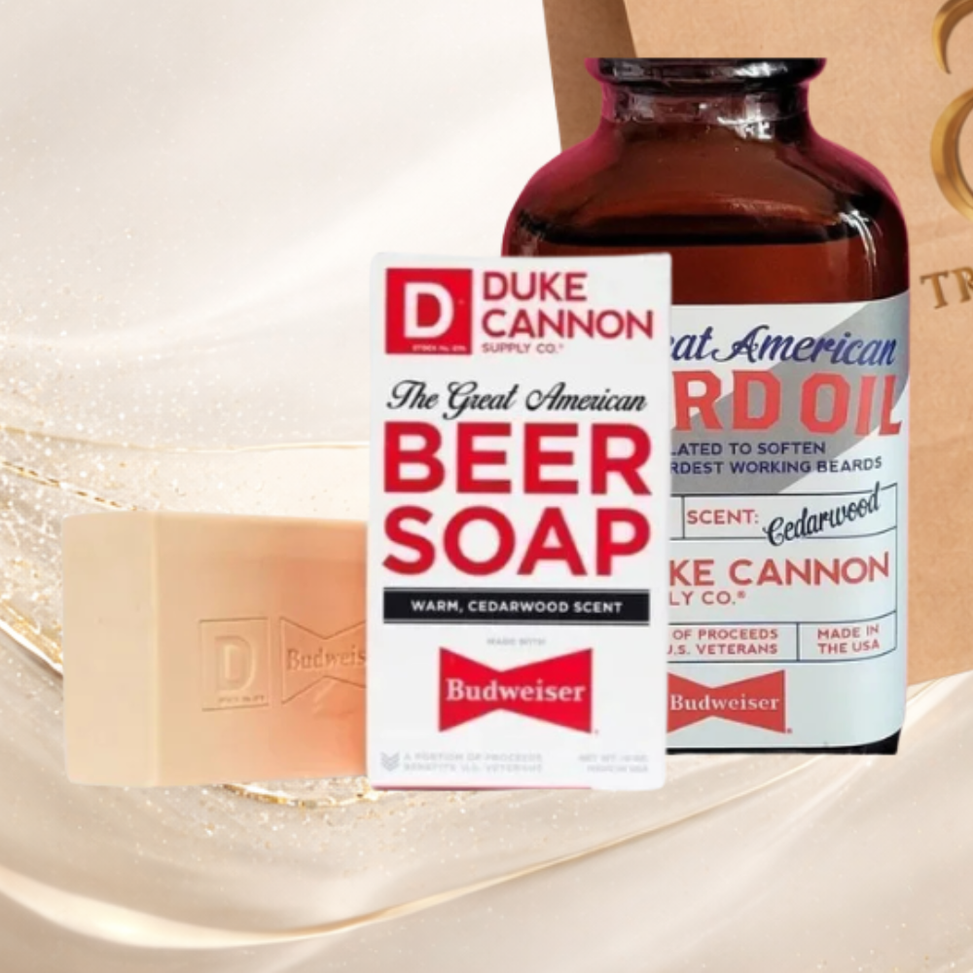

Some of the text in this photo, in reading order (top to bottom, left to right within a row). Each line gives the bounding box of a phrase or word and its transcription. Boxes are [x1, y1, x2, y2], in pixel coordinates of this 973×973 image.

[482, 272, 588, 301] DUKE
[404, 282, 454, 339] D
[481, 309, 653, 340] CANNON
[481, 342, 530, 354] SUPPLY
[670, 324, 897, 365] at American
[386, 380, 647, 420] The Great American
[800, 372, 903, 436] OIL
[384, 421, 652, 495] BEER
[728, 442, 752, 455] TO
[757, 441, 826, 455] SOFTEN
[729, 460, 811, 474] WORKING
[816, 456, 882, 474] BEARDS
[686, 509, 759, 525] SCENT:
[761, 480, 881, 547] Cedarwood
[382, 505, 652, 576] SOAP
[728, 551, 890, 586] CANNON
[410, 599, 623, 614] WARM, CEDARWOOD SCENT
[672, 628, 778, 640] OF PROCEEDS
[817, 624, 880, 639] MADE IN
[696, 643, 778, 655] VETERANS
[818, 639, 880, 654] THE USA
[445, 678, 586, 702] Budweiser
[669, 693, 780, 710] Budweiser
